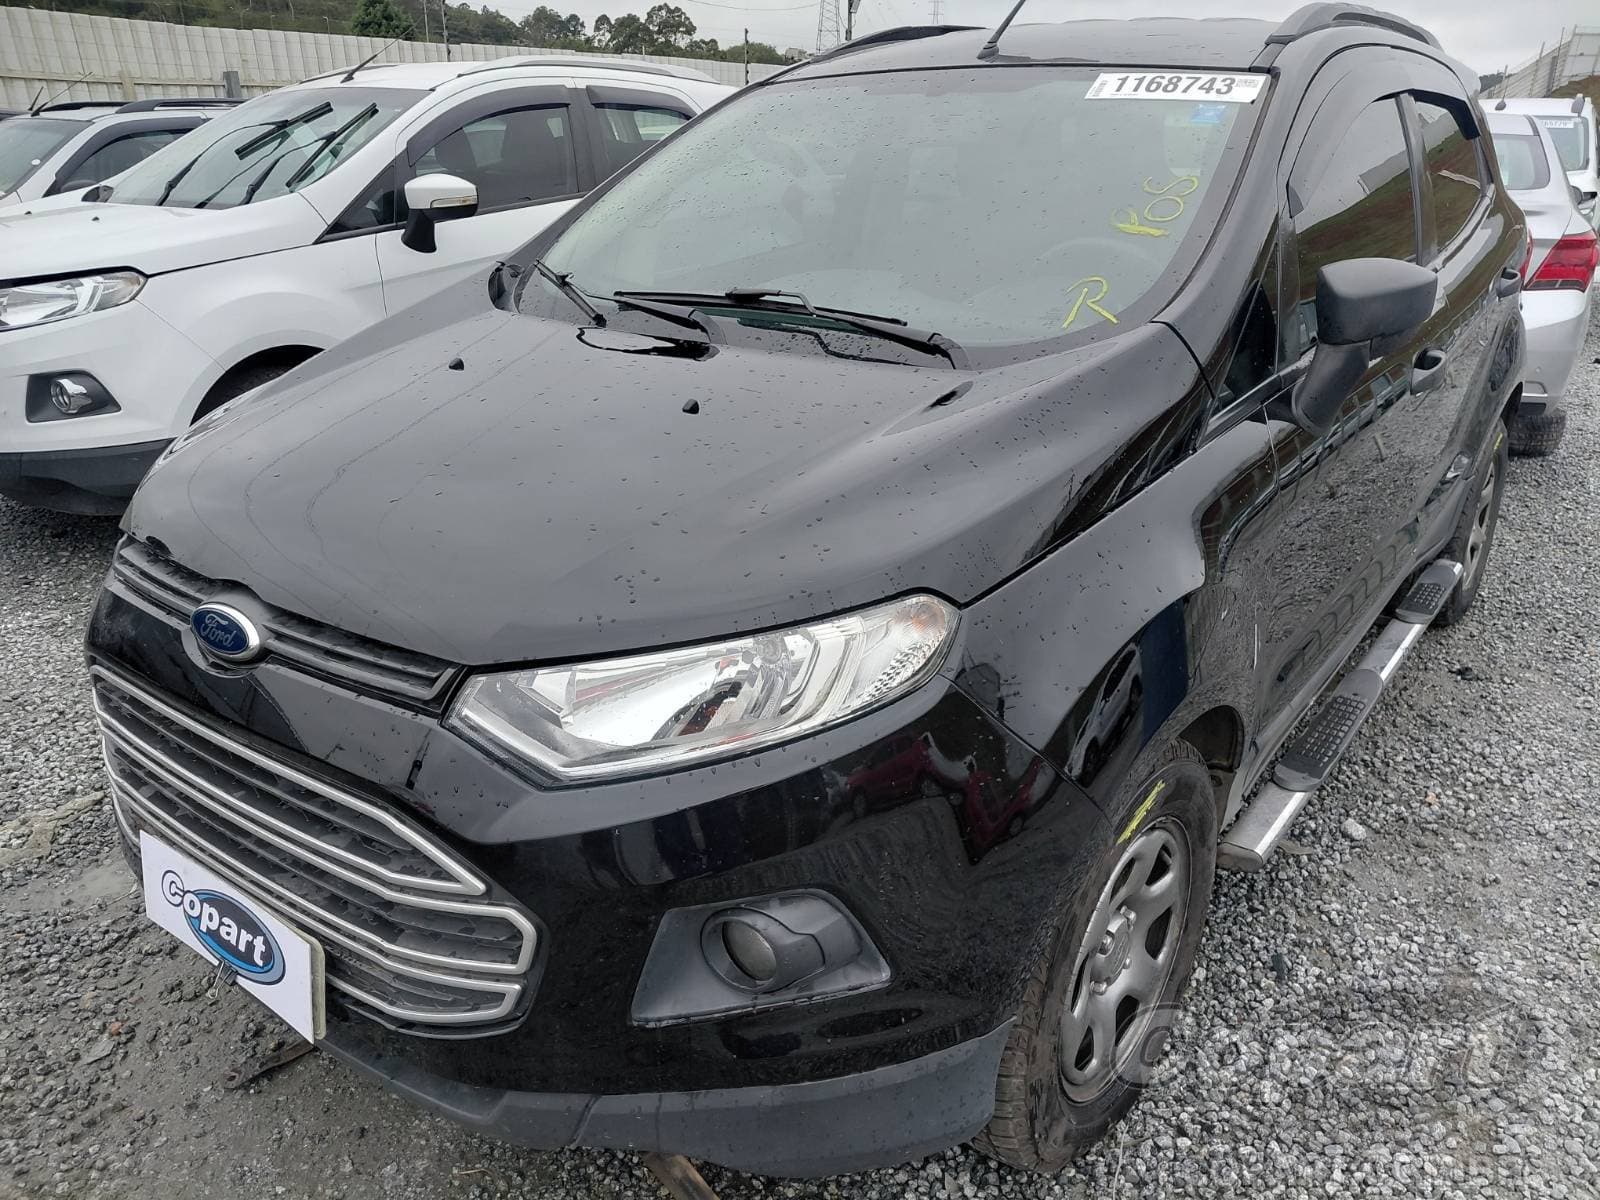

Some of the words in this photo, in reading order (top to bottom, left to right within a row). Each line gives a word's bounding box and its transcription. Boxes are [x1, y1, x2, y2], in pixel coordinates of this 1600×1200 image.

[1114, 74, 1236, 95] 1168743
[200, 613, 238, 648] Ford
[161, 869, 266, 968] Copart
